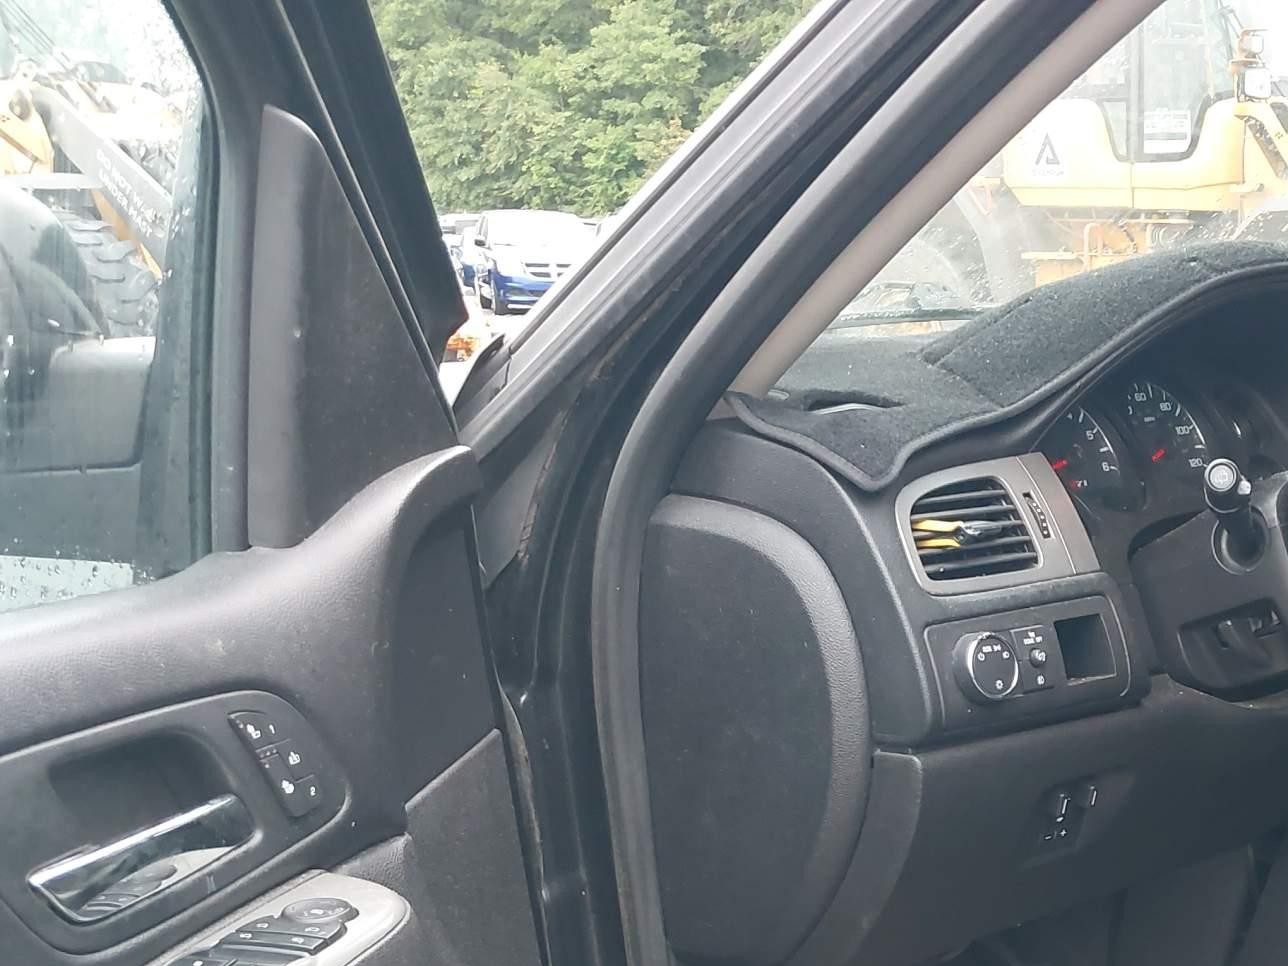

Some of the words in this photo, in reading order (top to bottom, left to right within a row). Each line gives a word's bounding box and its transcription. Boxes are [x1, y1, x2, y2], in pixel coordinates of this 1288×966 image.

[1134, 392, 1147, 402] 60
[1160, 402, 1172, 412] 80
[1086, 430, 1094, 441] 5
[1175, 425, 1191, 436] 100
[1102, 461, 1110, 472] 6
[1188, 458, 1204, 468] 120
[310, 786, 316, 796] 2
